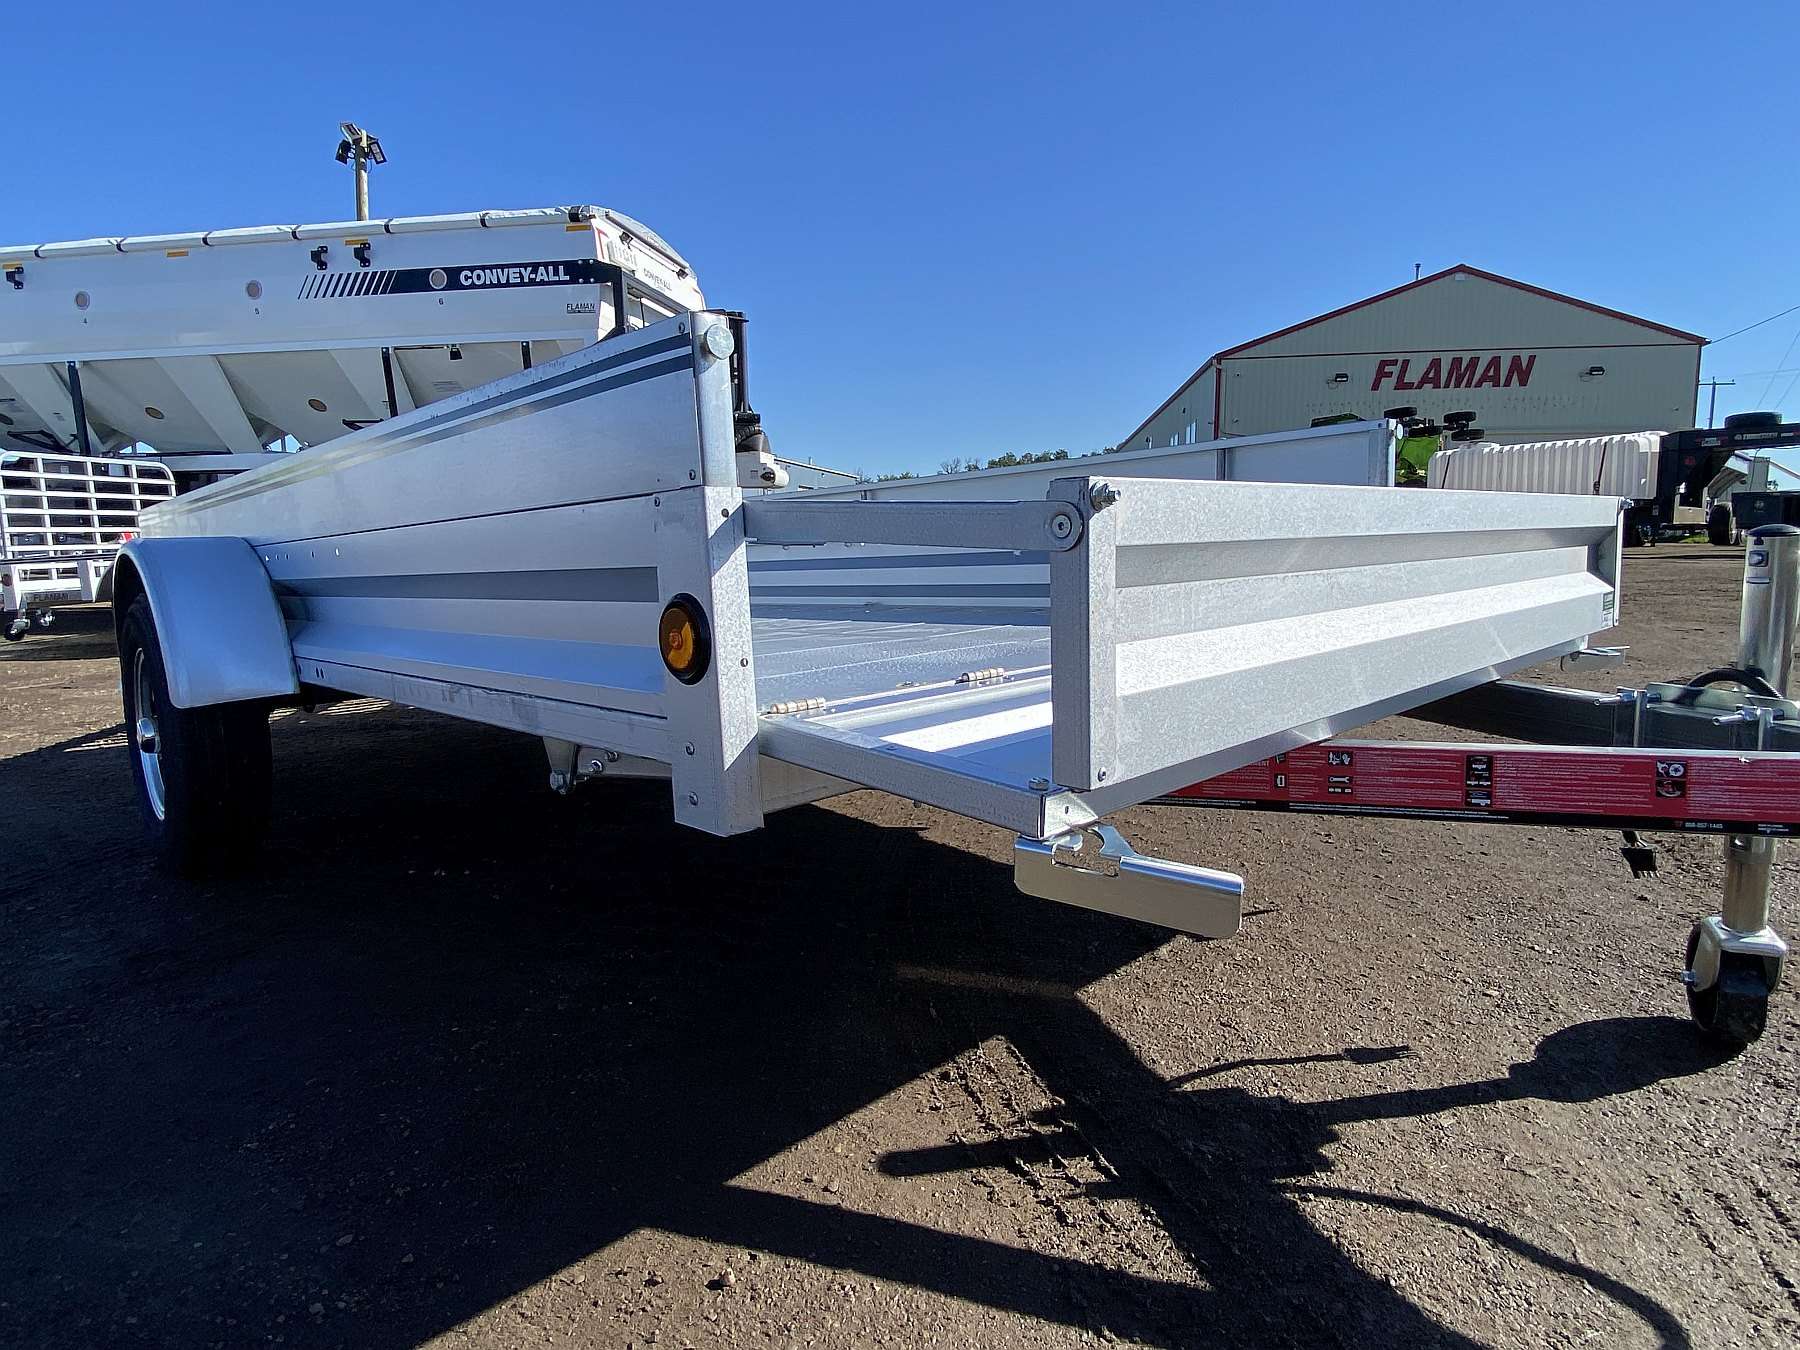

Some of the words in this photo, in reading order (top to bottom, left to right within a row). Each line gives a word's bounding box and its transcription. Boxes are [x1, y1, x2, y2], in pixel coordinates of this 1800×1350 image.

[459, 265, 570, 286] CONVEY-ALL
[566, 302, 595, 310] FLAMAN
[1370, 354, 1537, 392] FLAMAN
